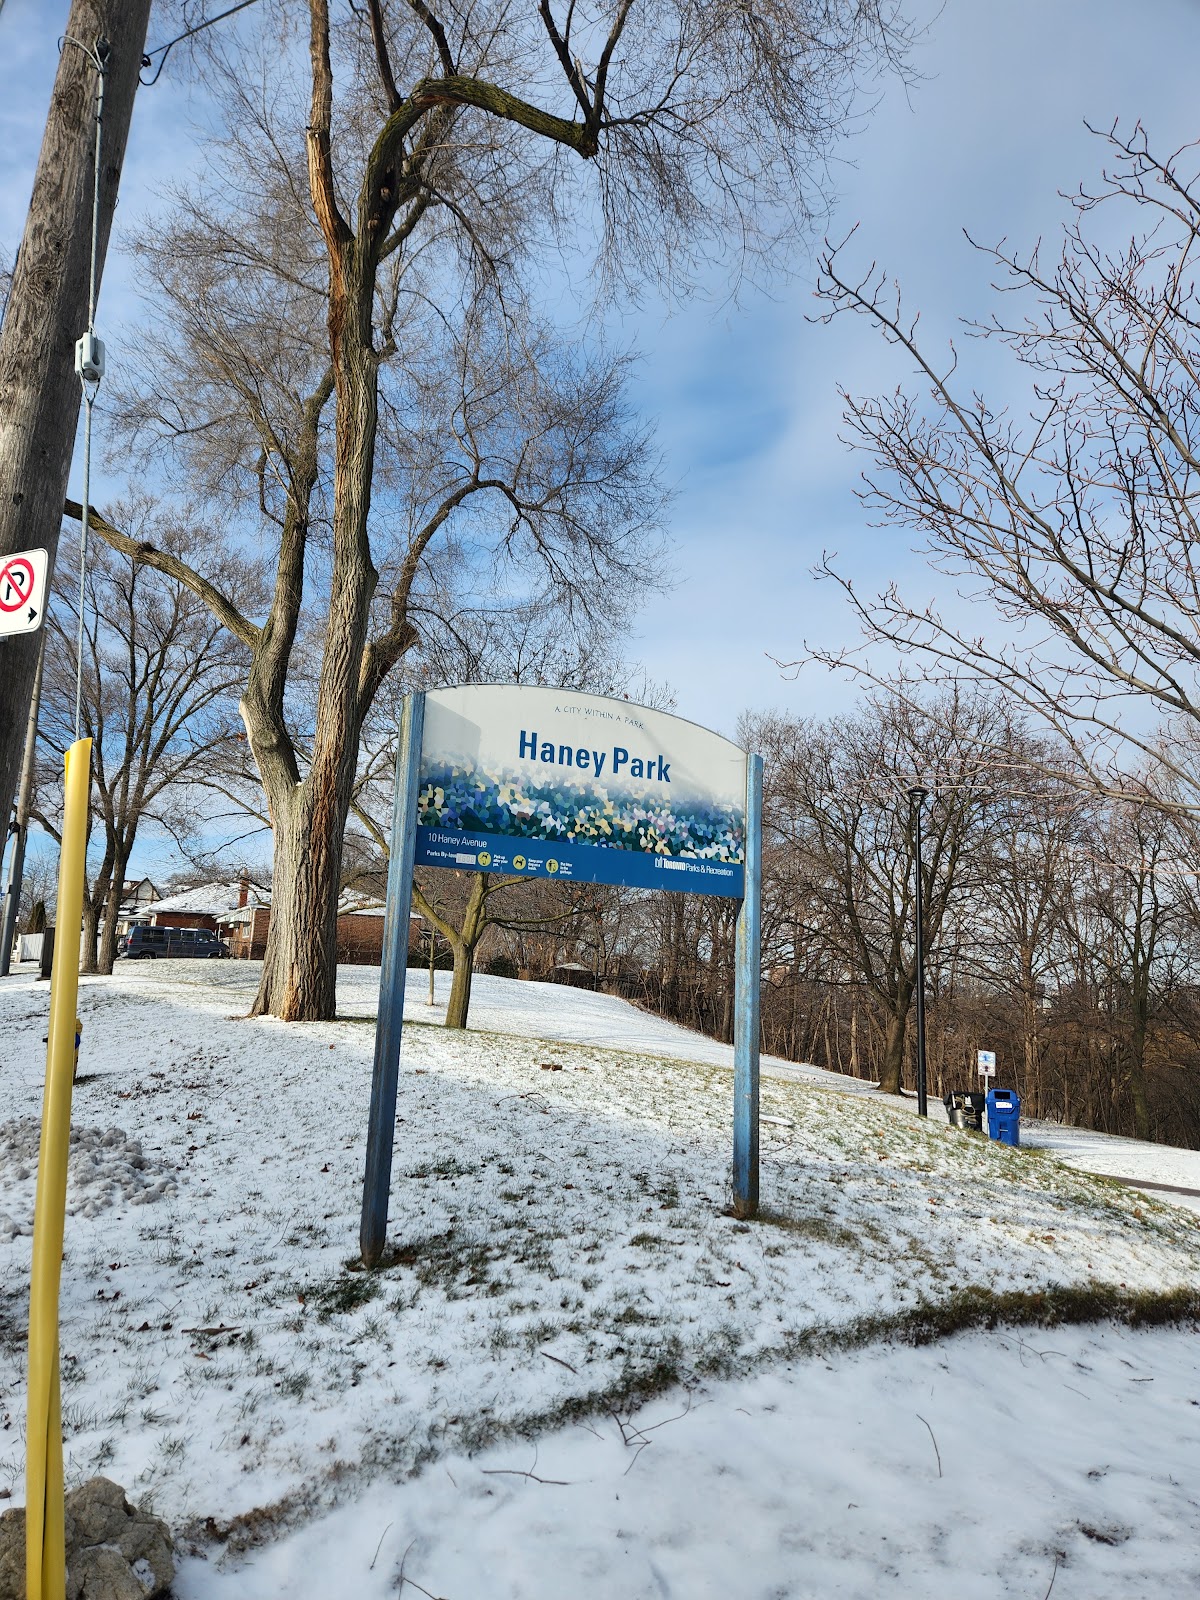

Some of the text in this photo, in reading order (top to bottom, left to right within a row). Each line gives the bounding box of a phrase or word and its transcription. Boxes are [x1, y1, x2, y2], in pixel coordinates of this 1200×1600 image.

[563, 706, 582, 714] CITY
[584, 707, 614, 719] WITHIN
[624, 716, 644, 730] PARK
[519, 730, 671, 783] Haney Park
[428, 832, 488, 848] 10 Haney Avenue
[426, 849, 441, 857] Parks
[685, 862, 700, 873] Parks
[700, 864, 706, 874] &
[706, 865, 734, 877] Recreation
